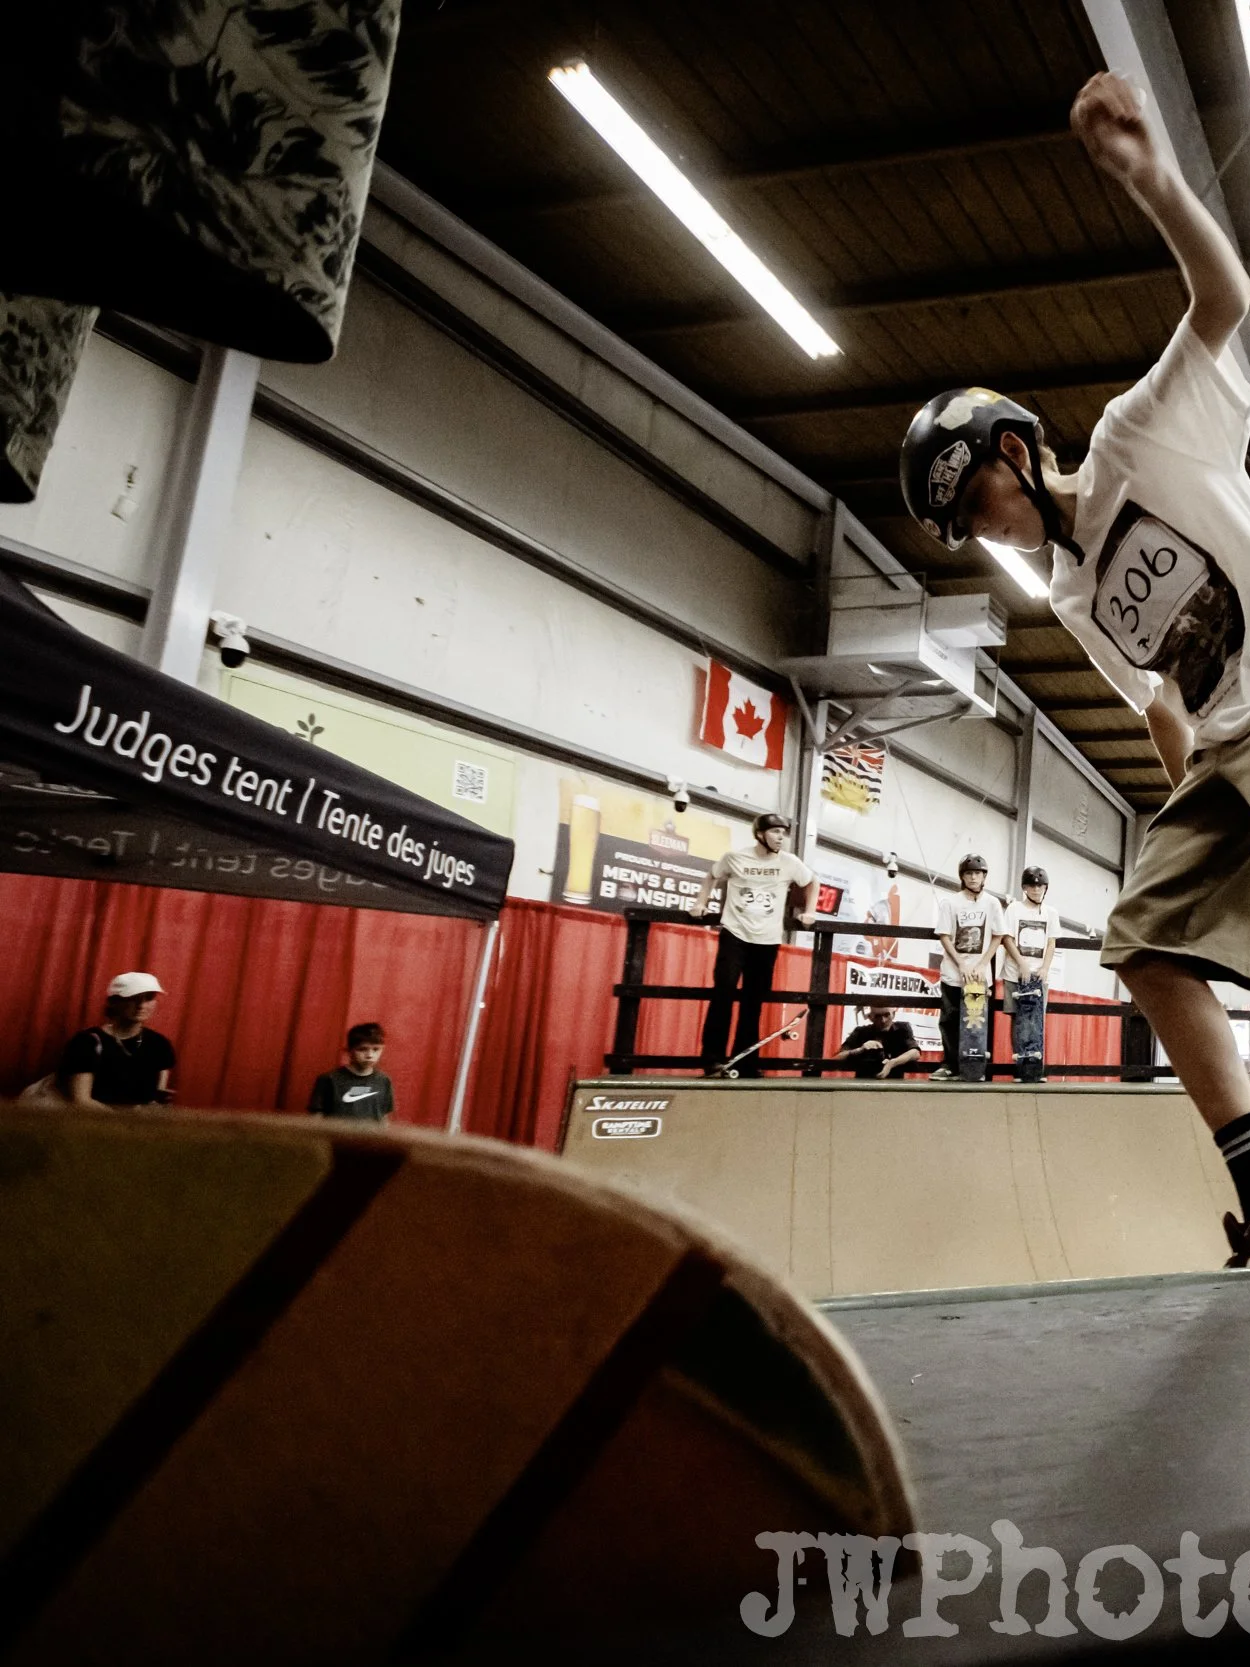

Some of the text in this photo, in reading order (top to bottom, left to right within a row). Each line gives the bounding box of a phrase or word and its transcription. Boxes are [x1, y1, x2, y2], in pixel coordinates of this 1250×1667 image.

[1110, 547, 1178, 634] 306
[54, 685, 217, 783] Judges
[222, 756, 293, 815] tent
[318, 790, 384, 850] Tente
[387, 825, 426, 866] des
[423, 841, 476, 889] juges
[603, 864, 722, 900] MEN'S & OPN
[743, 867, 781, 877] REVERT
[960, 911, 984, 921] 307
[585, 1096, 669, 1110] SKATELITE
